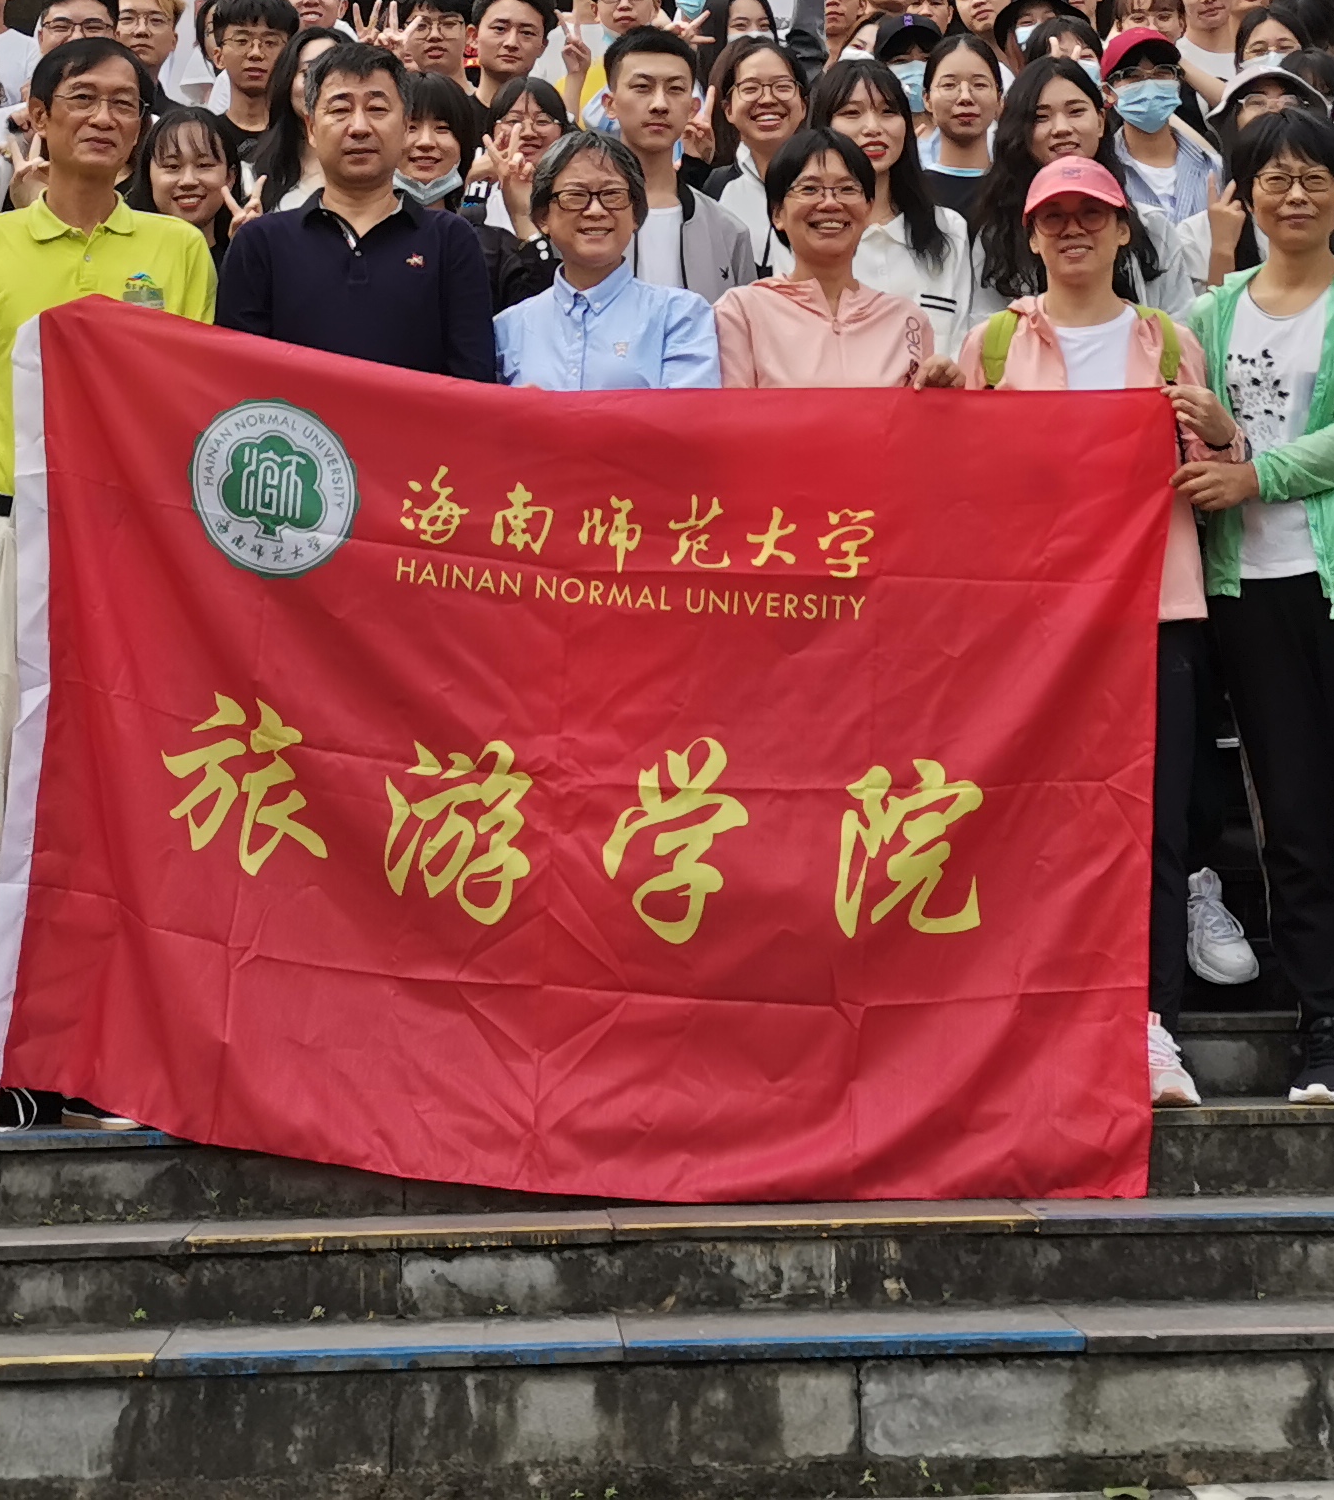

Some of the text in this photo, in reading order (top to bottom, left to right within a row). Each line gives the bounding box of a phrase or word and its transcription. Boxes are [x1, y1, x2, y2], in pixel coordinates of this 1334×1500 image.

[905, 316, 921, 360] neo
[204, 412, 346, 510] HAINAN NORMAL UNIVERSITY
[400, 465, 876, 579] 海南师范大学
[396, 557, 867, 621] HAINAN NORMAL UNIVERSITY
[160, 692, 984, 944] 旅游学院
